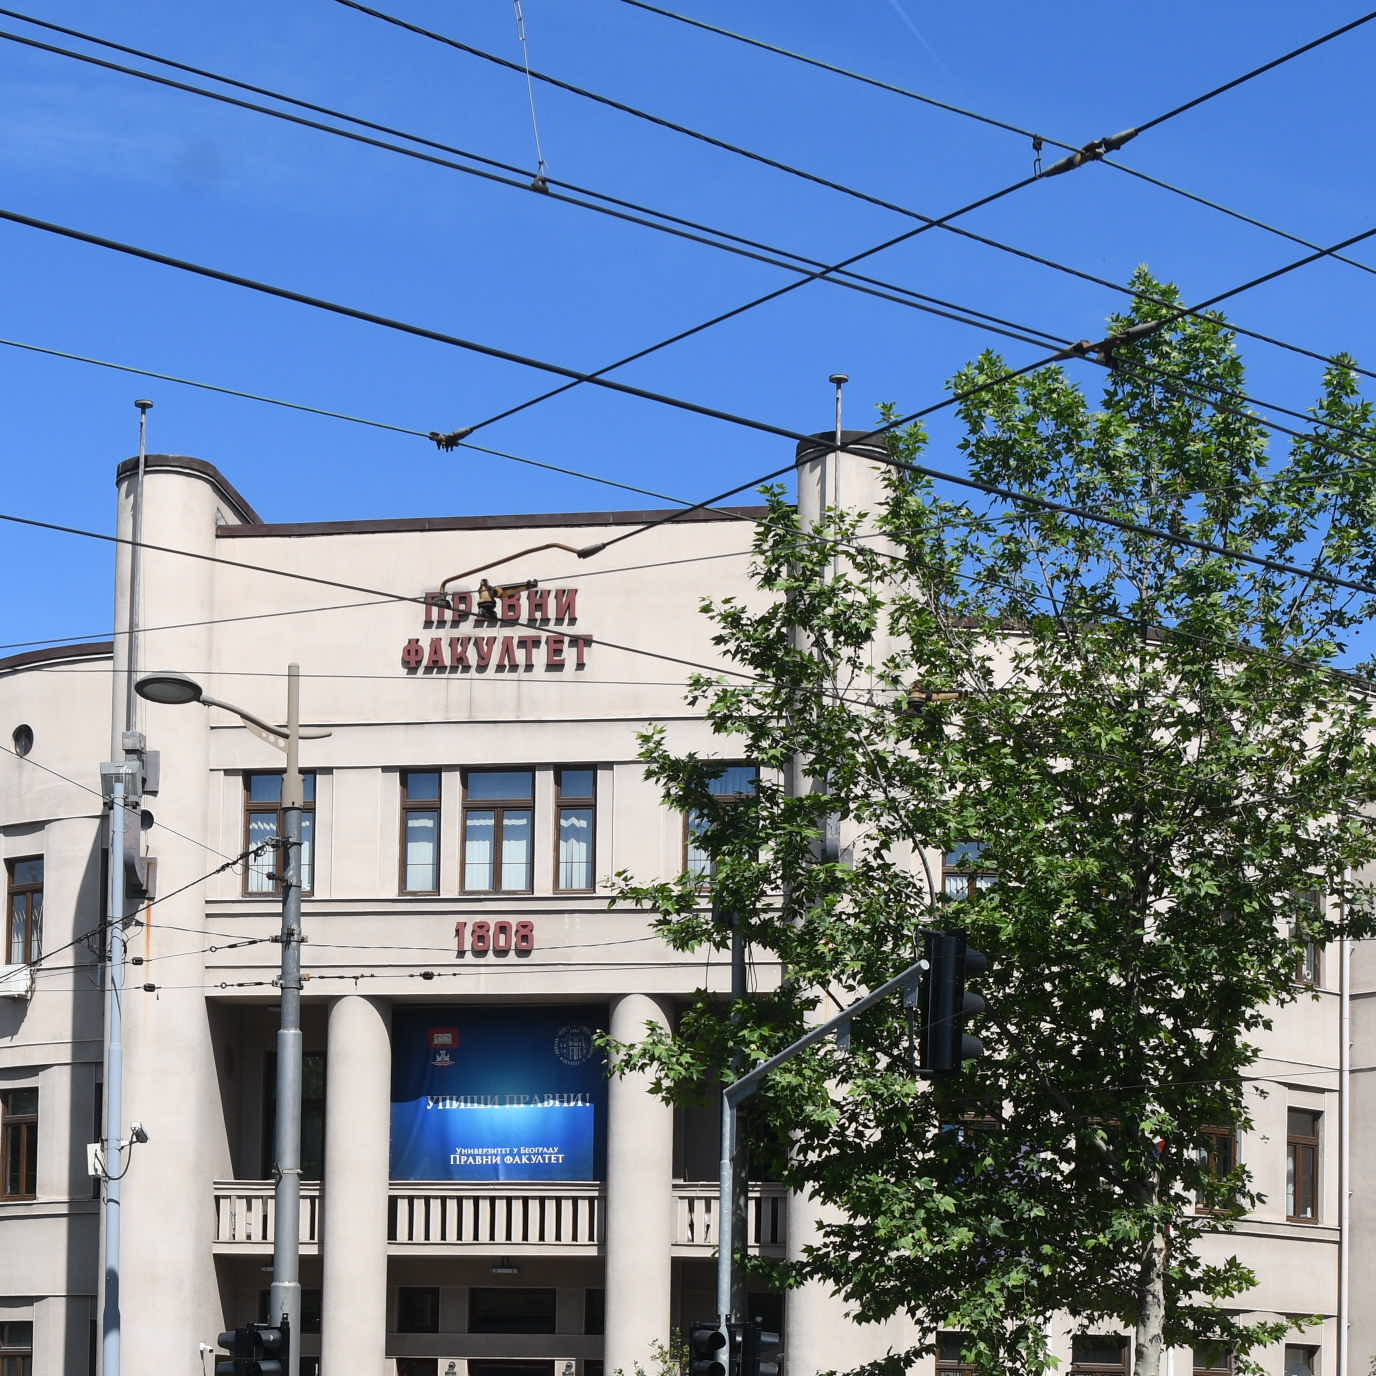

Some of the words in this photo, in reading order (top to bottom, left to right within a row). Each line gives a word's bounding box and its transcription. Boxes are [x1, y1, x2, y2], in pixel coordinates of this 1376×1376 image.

[401, 634, 593, 671] ФАКУЛТЕТ
[455, 920, 535, 956] 1808
[504, 1154, 565, 1164] ФАКУЛТЕТ
